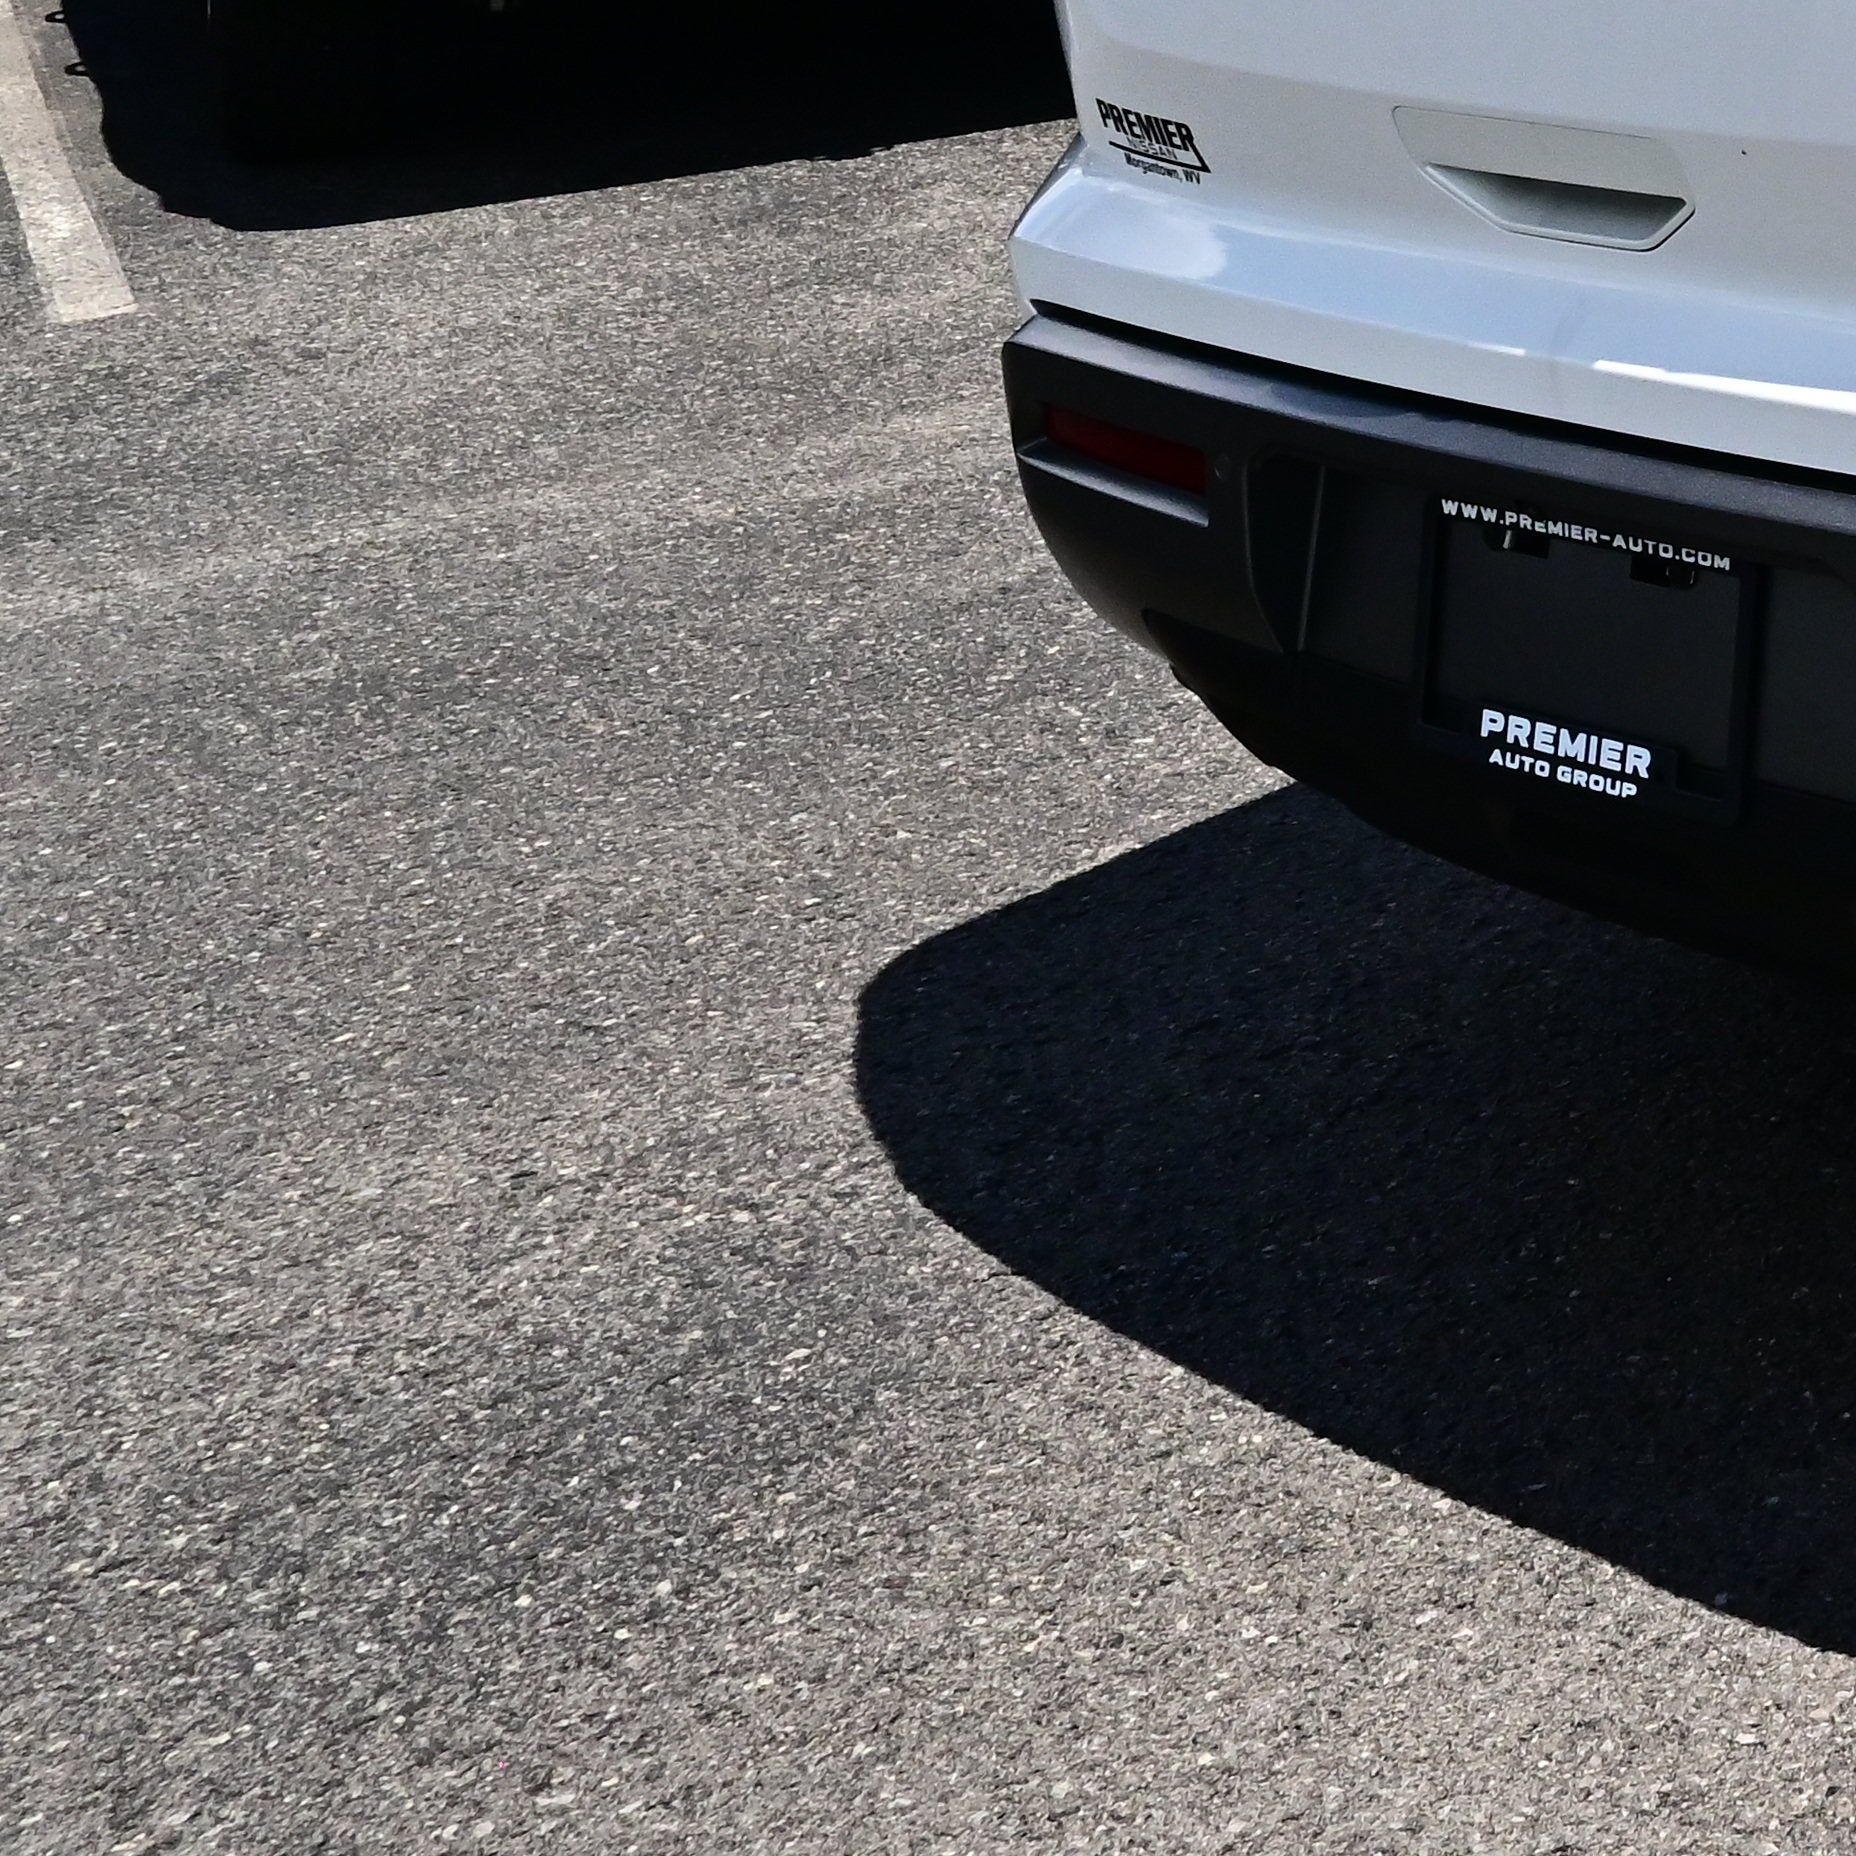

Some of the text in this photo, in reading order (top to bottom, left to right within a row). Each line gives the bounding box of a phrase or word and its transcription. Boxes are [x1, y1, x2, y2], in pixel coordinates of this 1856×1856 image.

[1095, 98, 1195, 153] PREMIER
[1126, 136, 1178, 160] NISSAN
[1182, 169, 1201, 185] WV
[1441, 499, 1731, 571] WWW.PREMIER-AUTO.COM
[1480, 708, 1652, 779] PREMIER
[1489, 748, 1638, 799] AUTO GROUP
